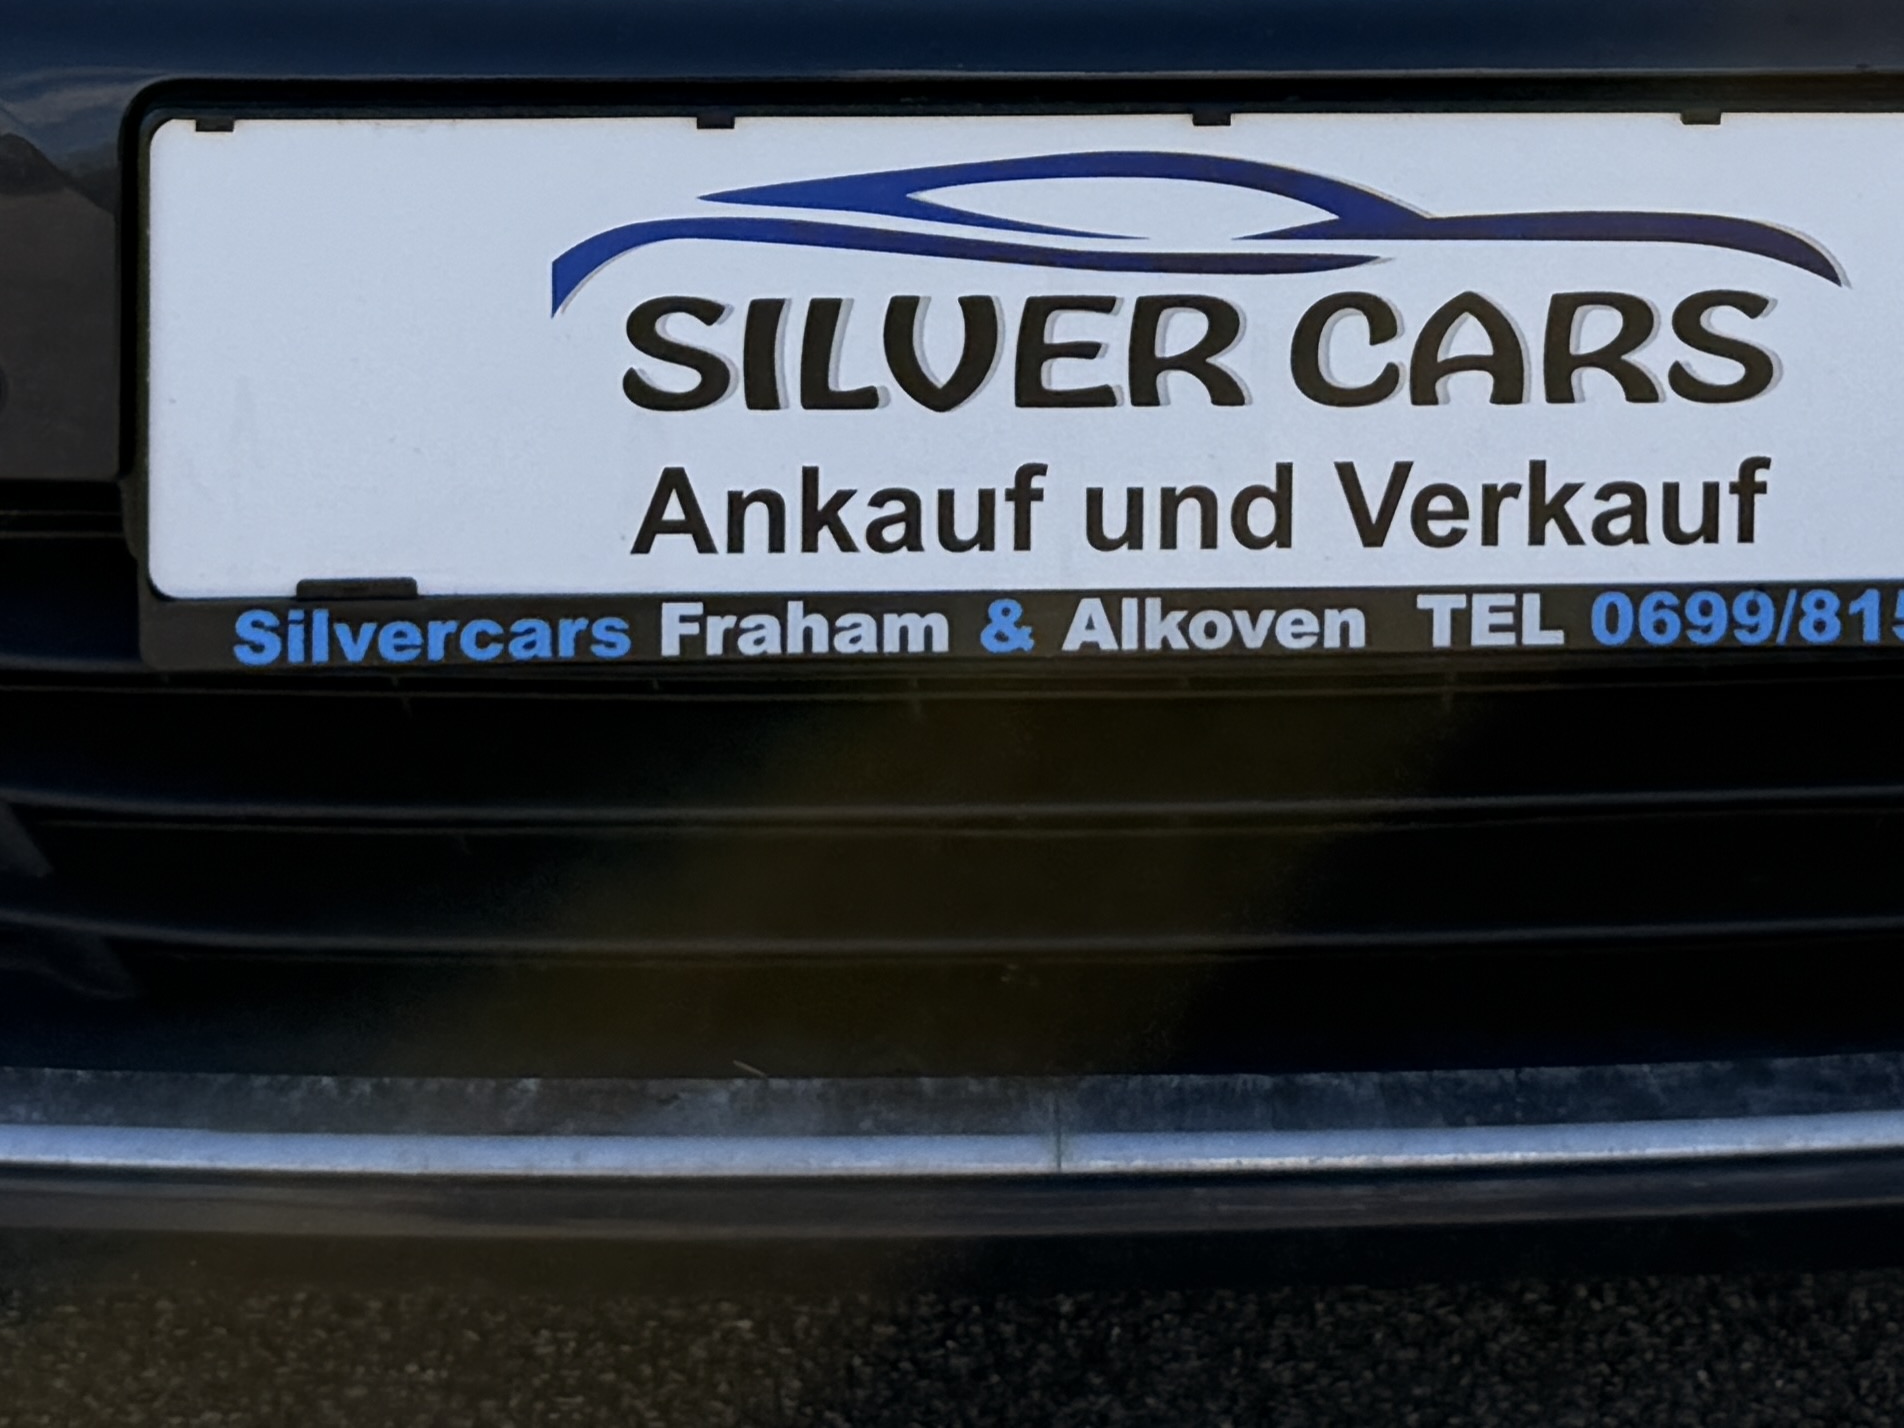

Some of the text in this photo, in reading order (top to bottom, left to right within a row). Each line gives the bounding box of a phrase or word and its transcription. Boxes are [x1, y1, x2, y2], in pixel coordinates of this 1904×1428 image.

[621, 288, 1783, 413] SILVER CARS
[629, 455, 1772, 555] Ankauf und Verkauf
[233, 608, 630, 667] Silvercars
[659, 601, 950, 657] Fraham
[979, 599, 1035, 654] &
[1062, 597, 1368, 652] Alkoven
[1416, 593, 1565, 647] TEL
